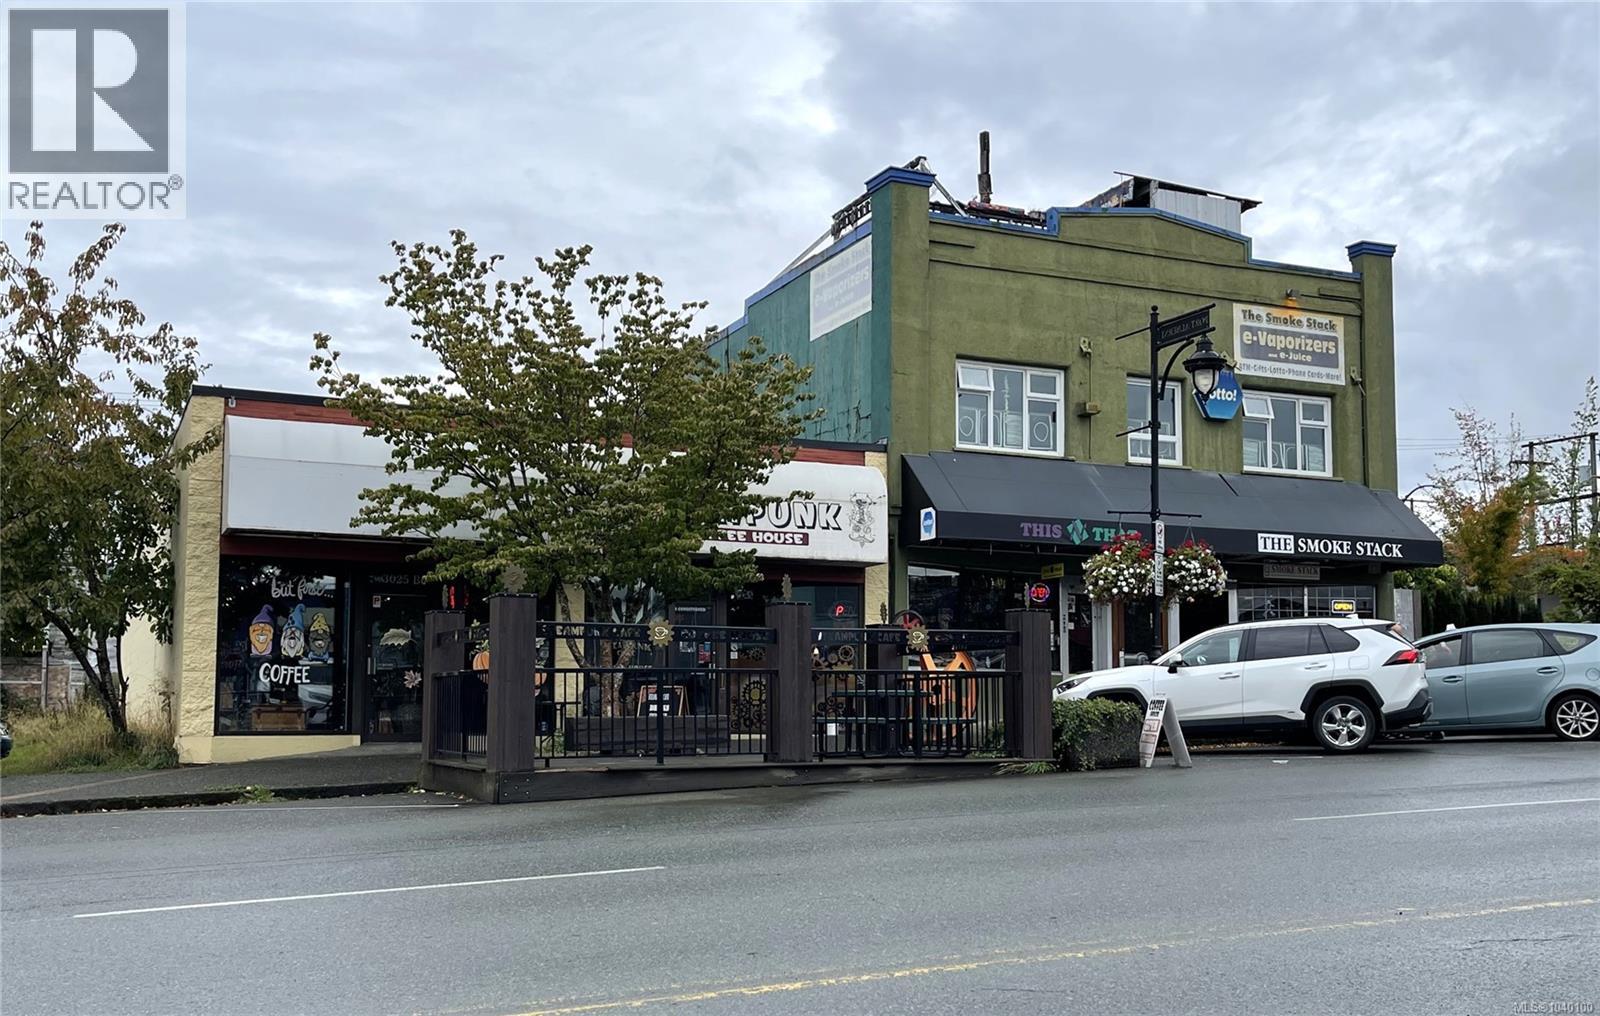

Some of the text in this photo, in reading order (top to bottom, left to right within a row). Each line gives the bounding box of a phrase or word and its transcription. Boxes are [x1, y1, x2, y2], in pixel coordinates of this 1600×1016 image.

[1241, 309, 1338, 331] The Smoke Stack
[1242, 330, 1337, 354] e-Vaporizers
[1279, 351, 1312, 362] e-Juice
[751, 531, 804, 545] HOUSE
[1020, 522, 1063, 538] THIS
[1259, 536, 1404, 558] THE SMOKE STACK
[271, 577, 296, 598] but
[259, 662, 311, 686] COFFEE
